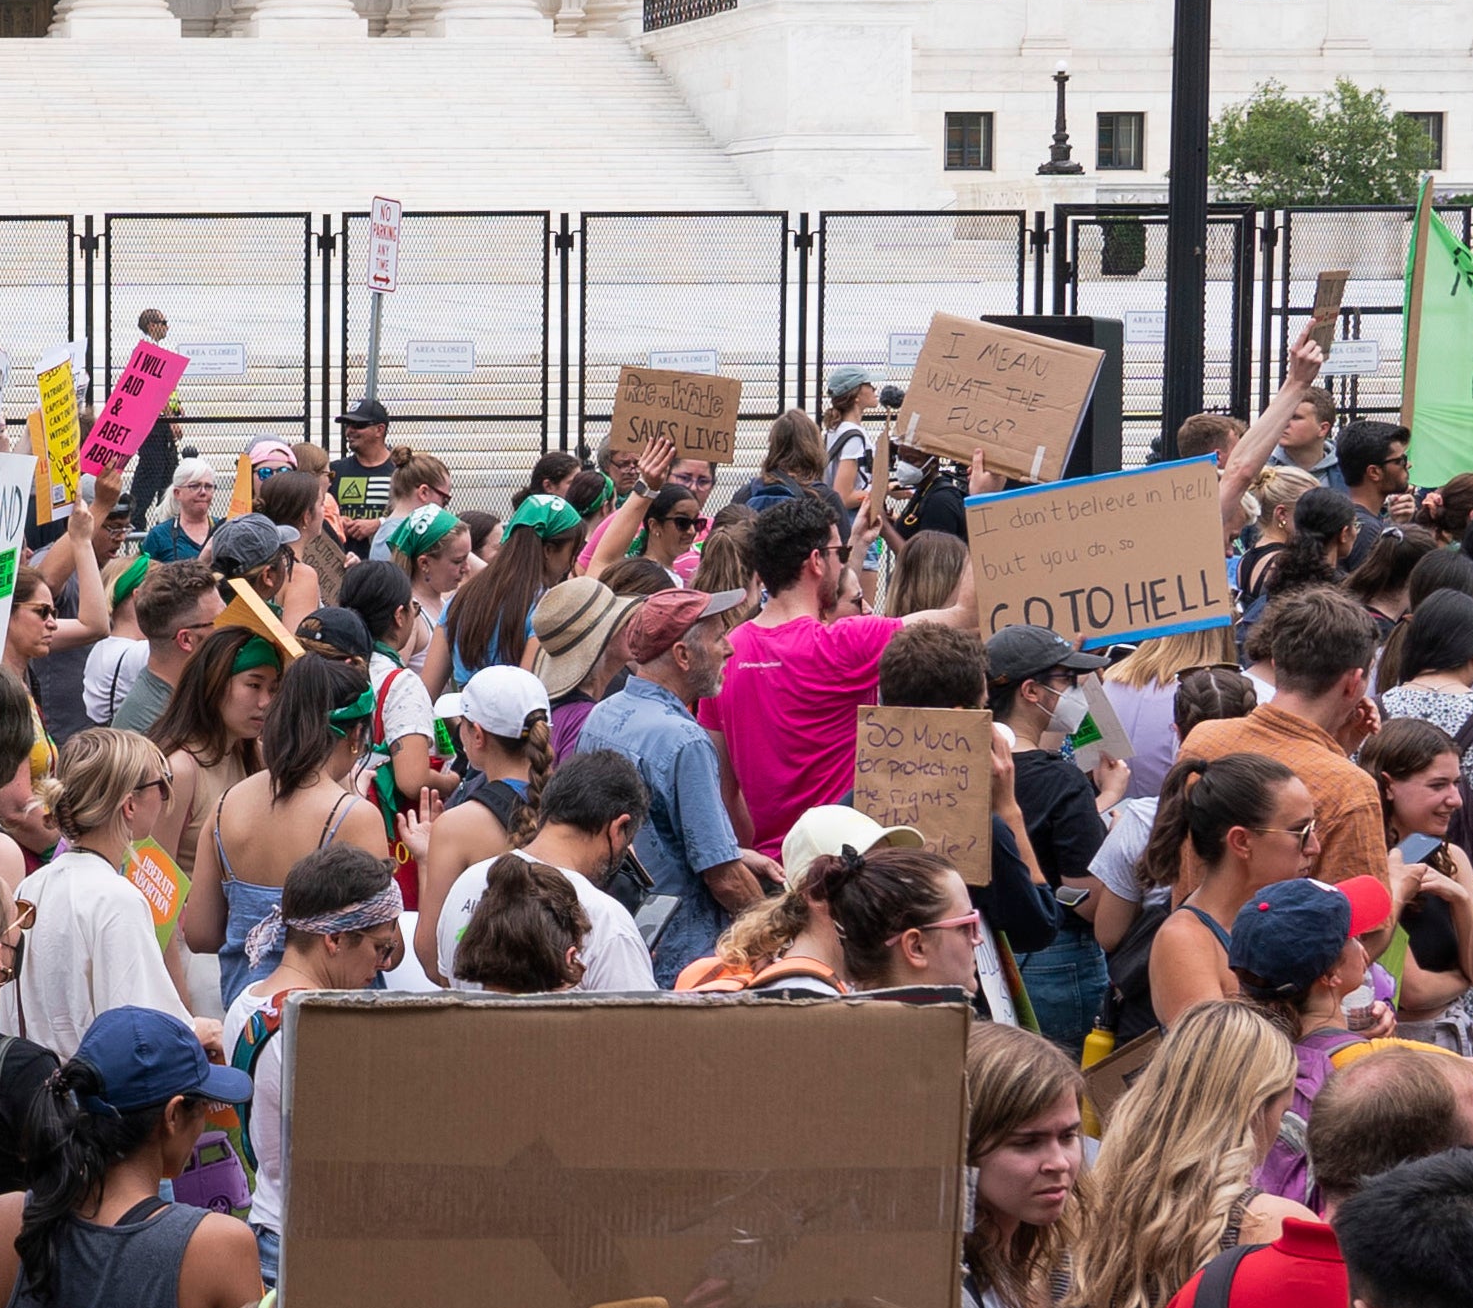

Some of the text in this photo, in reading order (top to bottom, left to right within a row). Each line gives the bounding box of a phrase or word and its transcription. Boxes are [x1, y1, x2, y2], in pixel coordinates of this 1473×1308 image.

[380, 203, 392, 221] NO
[372, 222, 397, 242] PARKING
[375, 257, 389, 273] TIME
[377, 243, 390, 258] ANY
[133, 351, 167, 379] I WILL
[942, 332, 1049, 380] I MEAN,
[121, 374, 145, 396] AID
[624, 373, 657, 407] Roe
[671, 379, 725, 419] Wade
[926, 367, 1046, 412] WHAT THE
[110, 398, 123, 417] &
[947, 406, 1016, 436] FUCK?
[97, 420, 132, 446] ABET
[627, 415, 730, 454] SAVES LIVES
[971, 477, 1212, 537] I don't believe in hell,
[981, 538, 1135, 581] but you do, so
[1060, 586, 1115, 634] TO
[1125, 570, 1221, 626] HELL
[887, 756, 970, 791] protecting
[857, 783, 959, 819] the rights
[132, 868, 170, 917] ABORTION
[142, 855, 176, 900] LIBERATE
